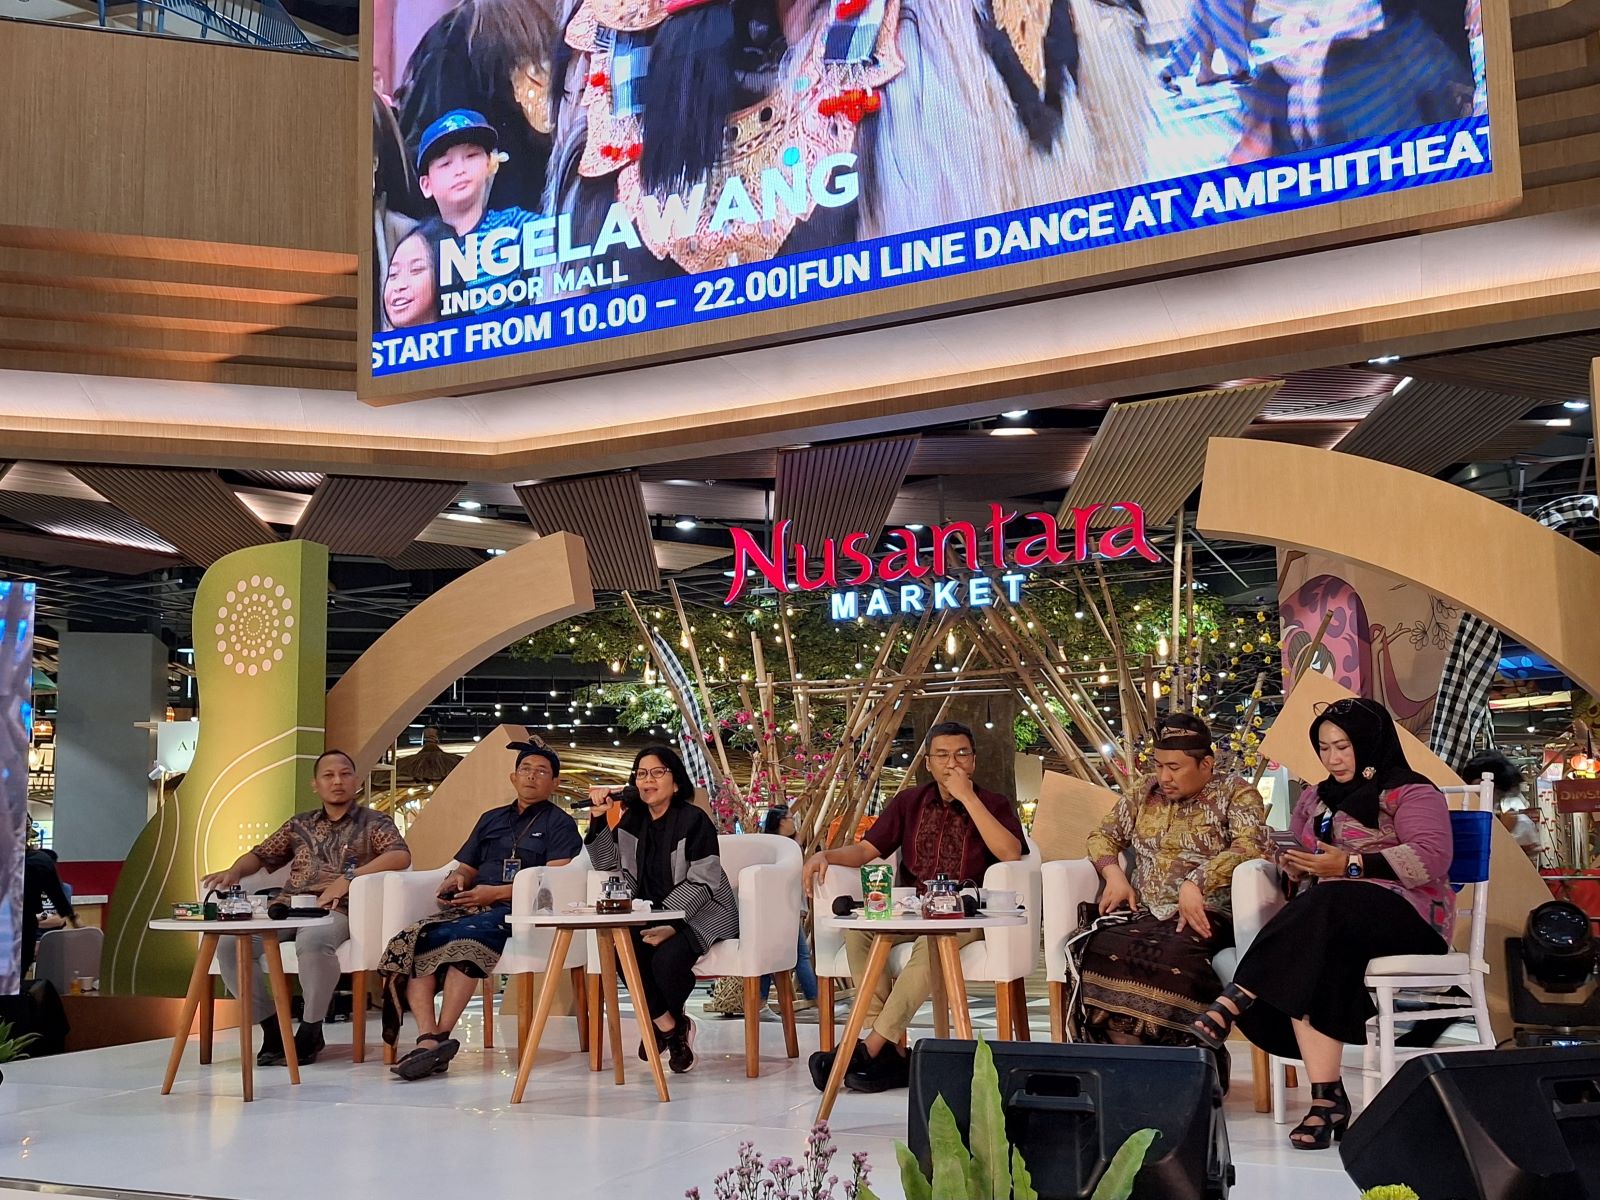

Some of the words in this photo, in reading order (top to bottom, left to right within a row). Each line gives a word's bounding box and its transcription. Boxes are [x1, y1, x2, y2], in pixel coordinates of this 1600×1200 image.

[439, 153, 860, 286] NGELAWANG
[440, 281, 544, 316] INDOOR
[553, 259, 629, 294] MALL
[465, 312, 551, 353] FROM
[561, 295, 646, 335] 10.00
[880, 232, 966, 278] LINE
[975, 203, 1114, 257] DANCE
[1124, 192, 1182, 231] AT
[723, 502, 1162, 606] Nusantara
[831, 574, 1026, 620] MARKET
